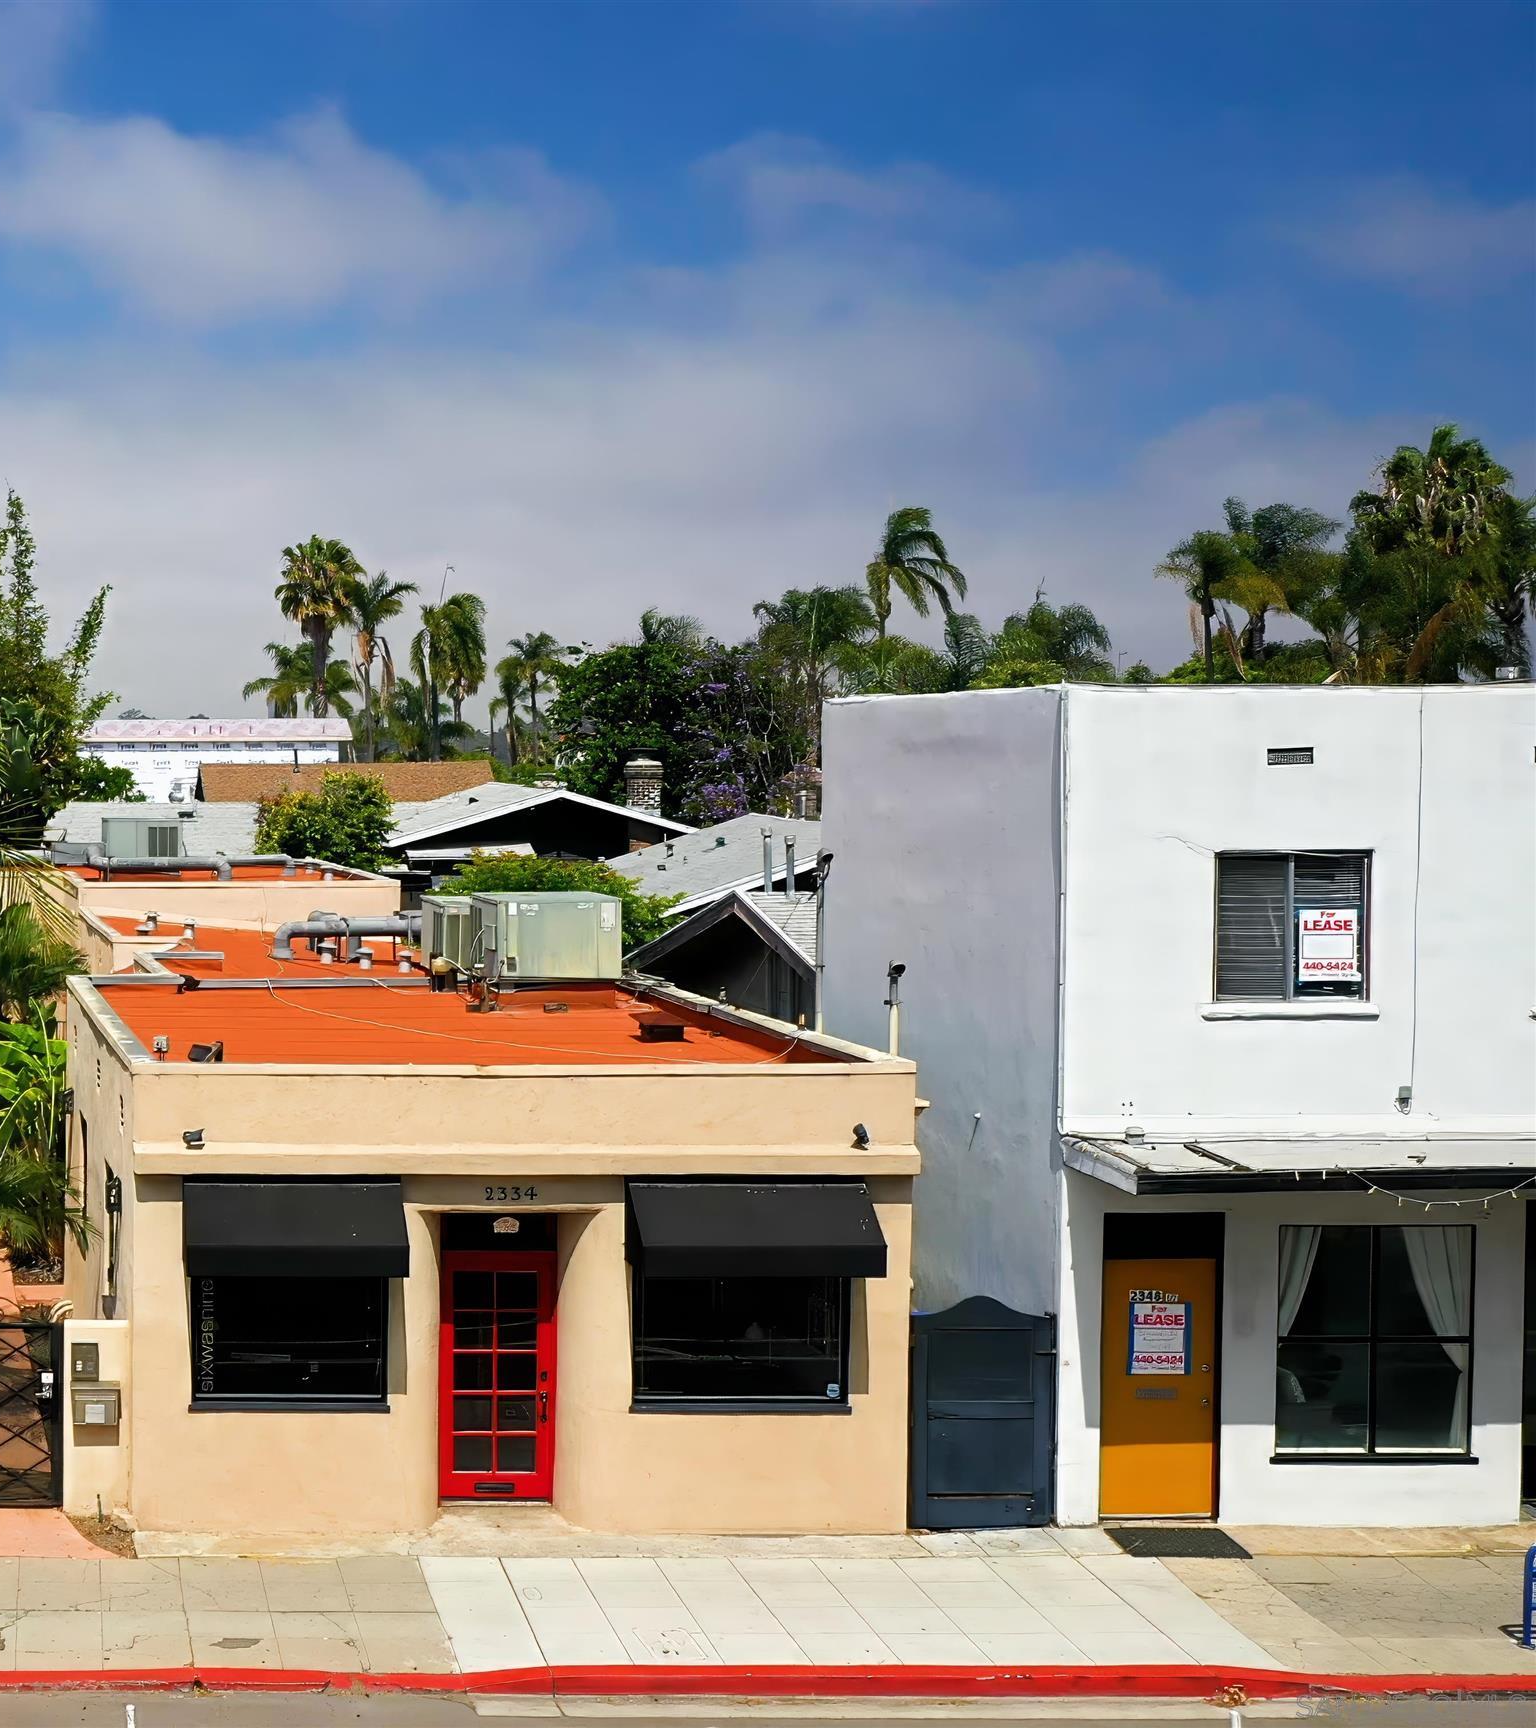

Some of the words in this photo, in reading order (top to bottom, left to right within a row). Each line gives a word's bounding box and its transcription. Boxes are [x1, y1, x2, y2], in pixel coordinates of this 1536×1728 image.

[1303, 920, 1353, 931] LEASE
[485, 1186, 538, 1201] 2334
[1134, 1314, 1185, 1326] LEASE
